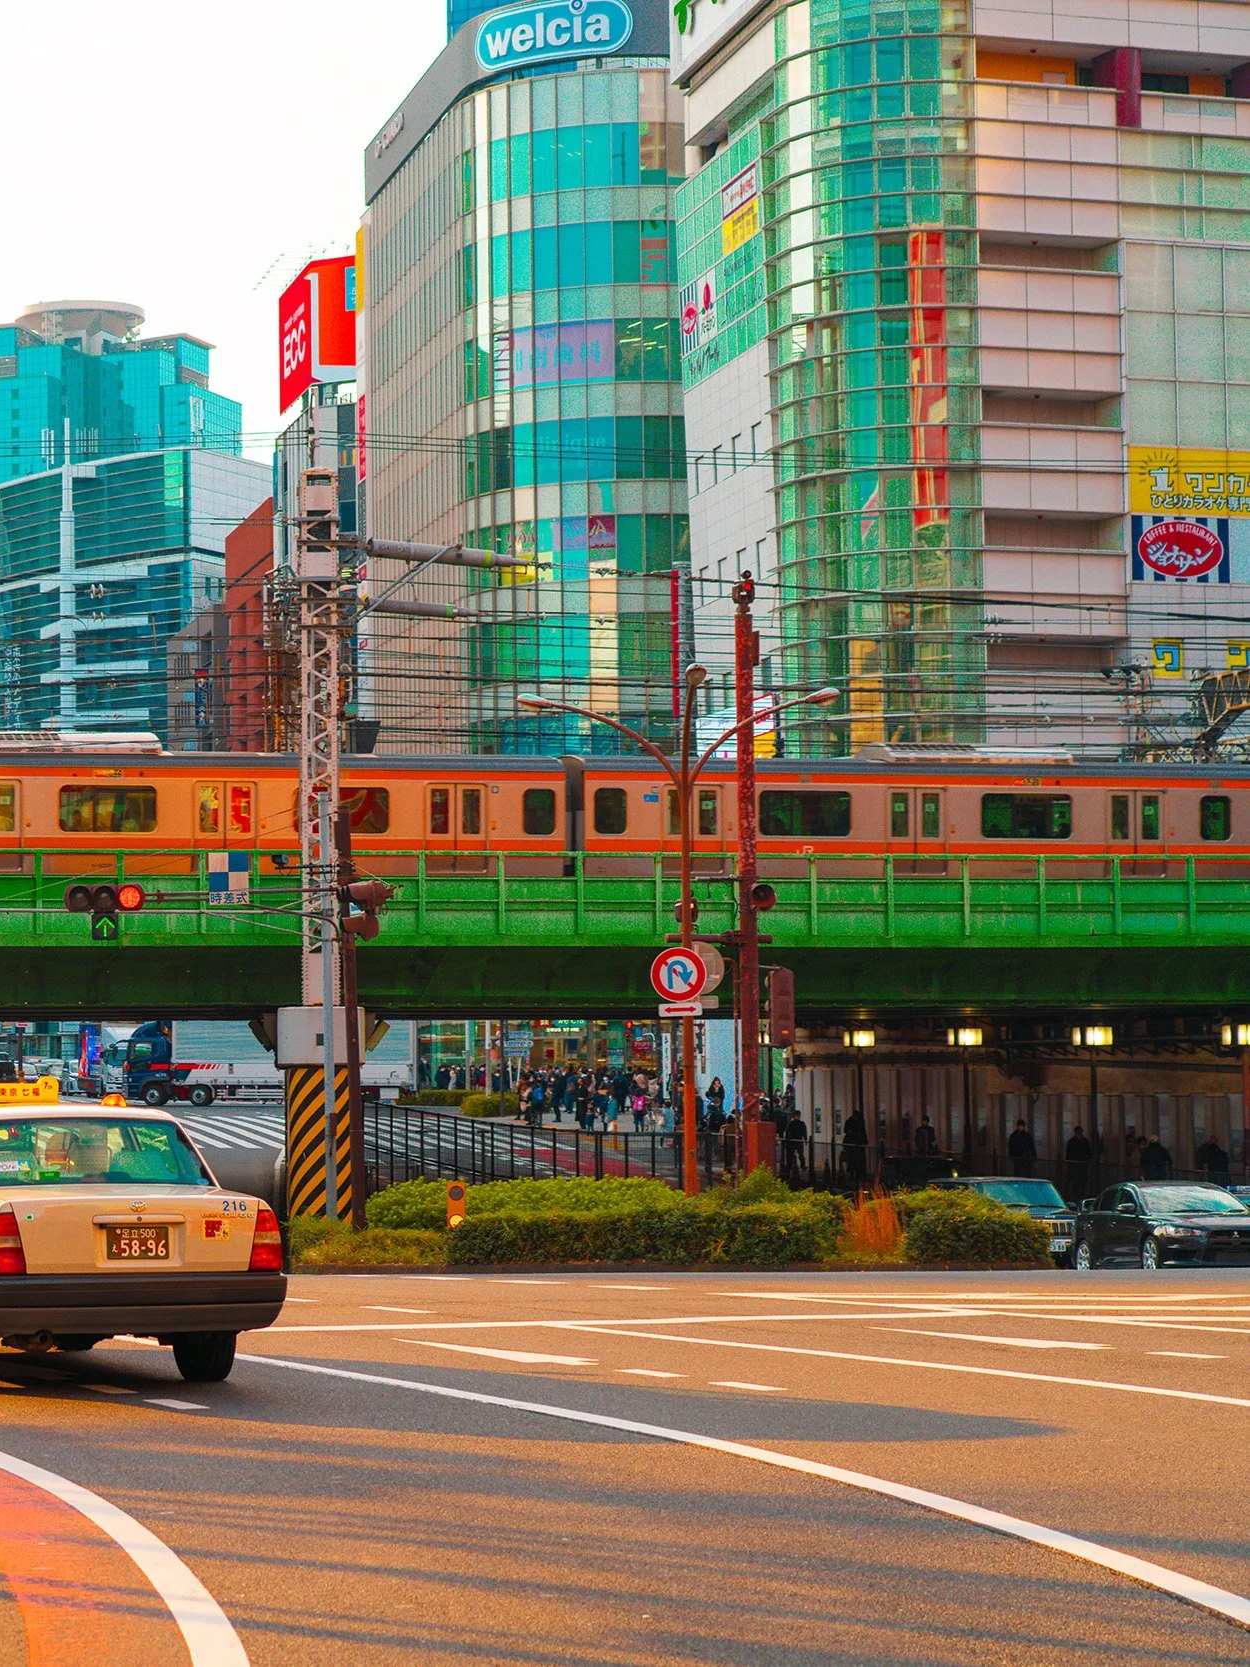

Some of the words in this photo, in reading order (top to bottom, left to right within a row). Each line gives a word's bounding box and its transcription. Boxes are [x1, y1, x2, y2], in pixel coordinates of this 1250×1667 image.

[485, 1, 610, 59] welcia
[283, 319, 306, 380] ECC
[1185, 473, 1250, 494] ワンカ
[1144, 525, 1167, 544] COFFEE
[1169, 523, 1175, 532] &
[1176, 523, 1218, 546] RESTAURANT
[210, 892, 249, 905] 時差式
[222, 1200, 247, 1212] 216
[120, 1240, 167, 1257] 58-96
